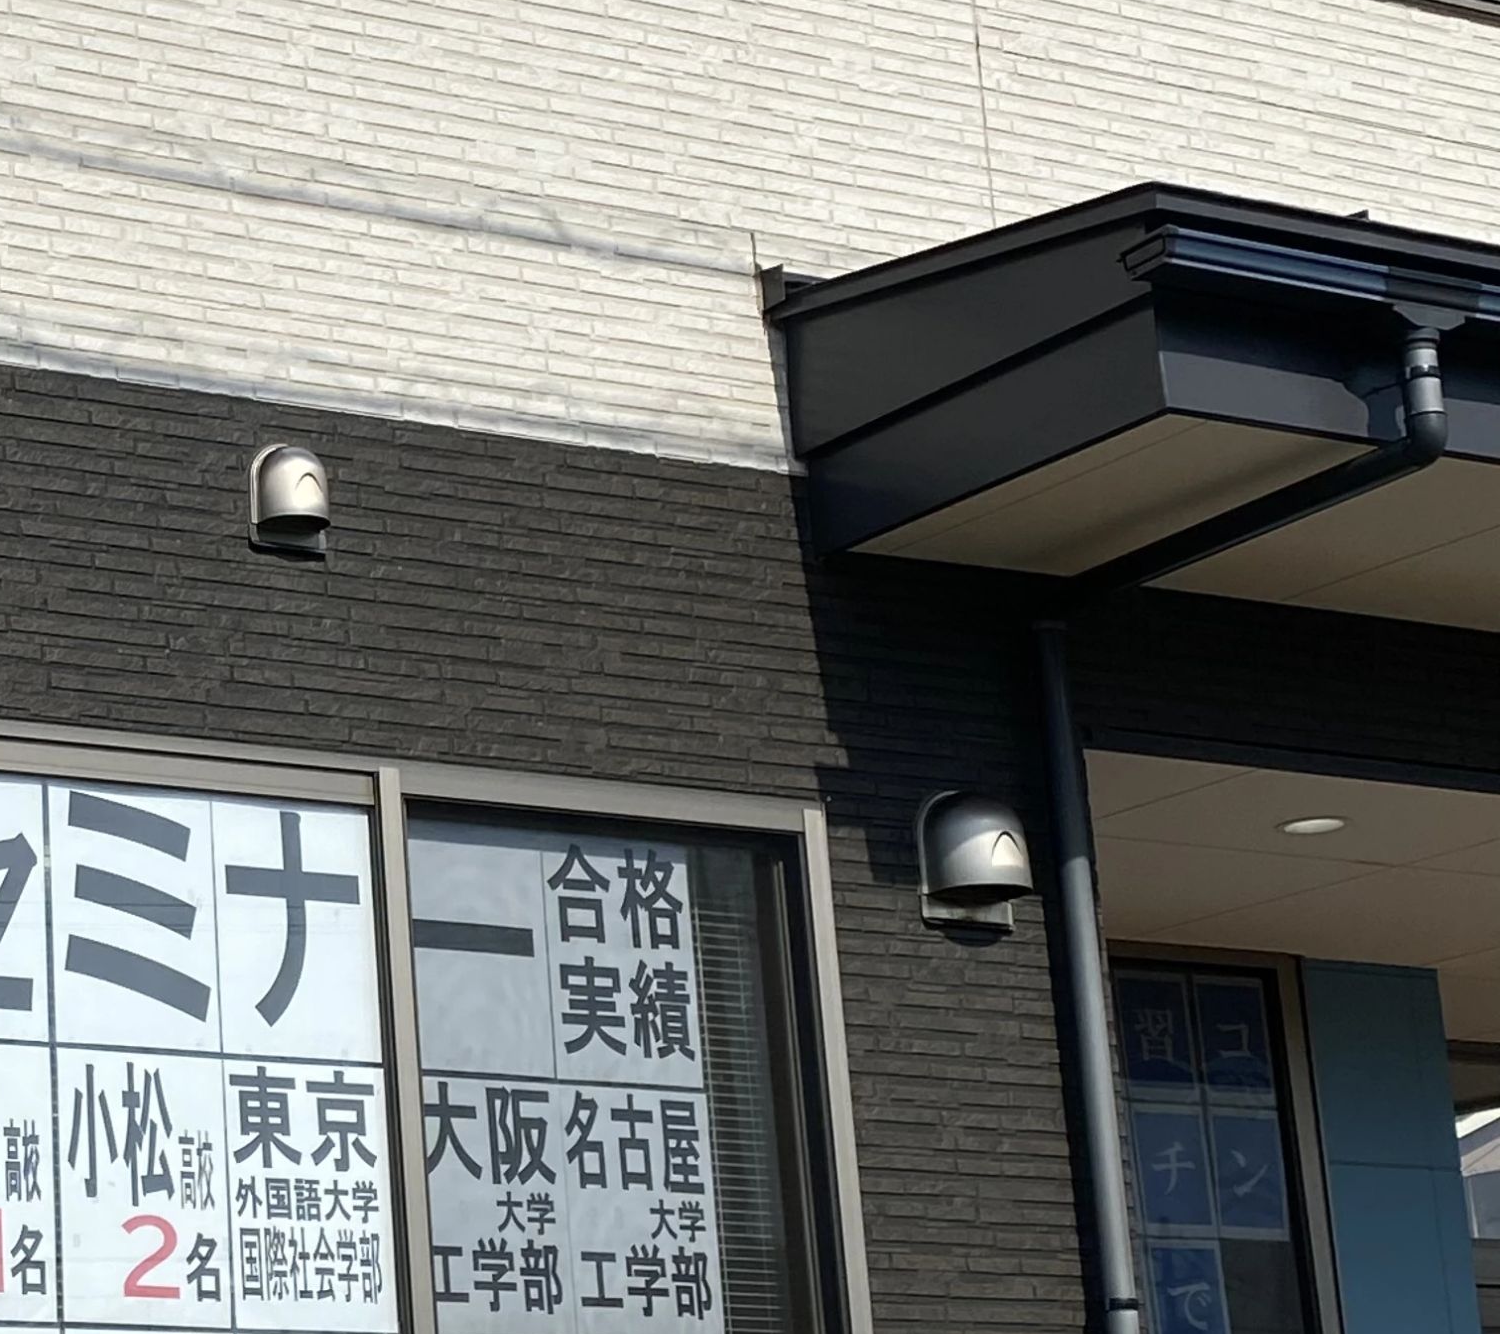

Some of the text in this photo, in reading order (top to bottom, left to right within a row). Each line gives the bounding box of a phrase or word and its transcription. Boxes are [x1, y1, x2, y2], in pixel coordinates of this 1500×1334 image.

[547, 844, 683, 950] 合格
[559, 956, 695, 1061] 実績
[68, 1062, 215, 1210] 小松高校
[229, 1066, 377, 1172] 東京
[423, 1082, 556, 1185] 大阪
[565, 1090, 705, 1195] 名古屋
[235, 1176, 379, 1223] 外国語大学
[497, 1191, 556, 1235] 大学
[650, 1199, 706, 1242] 大学
[121, 1214, 221, 1302] 2名
[239, 1226, 383, 1305] 国際社会学部
[433, 1238, 563, 1315] 工学部
[581, 1244, 713, 1320] 工学部
